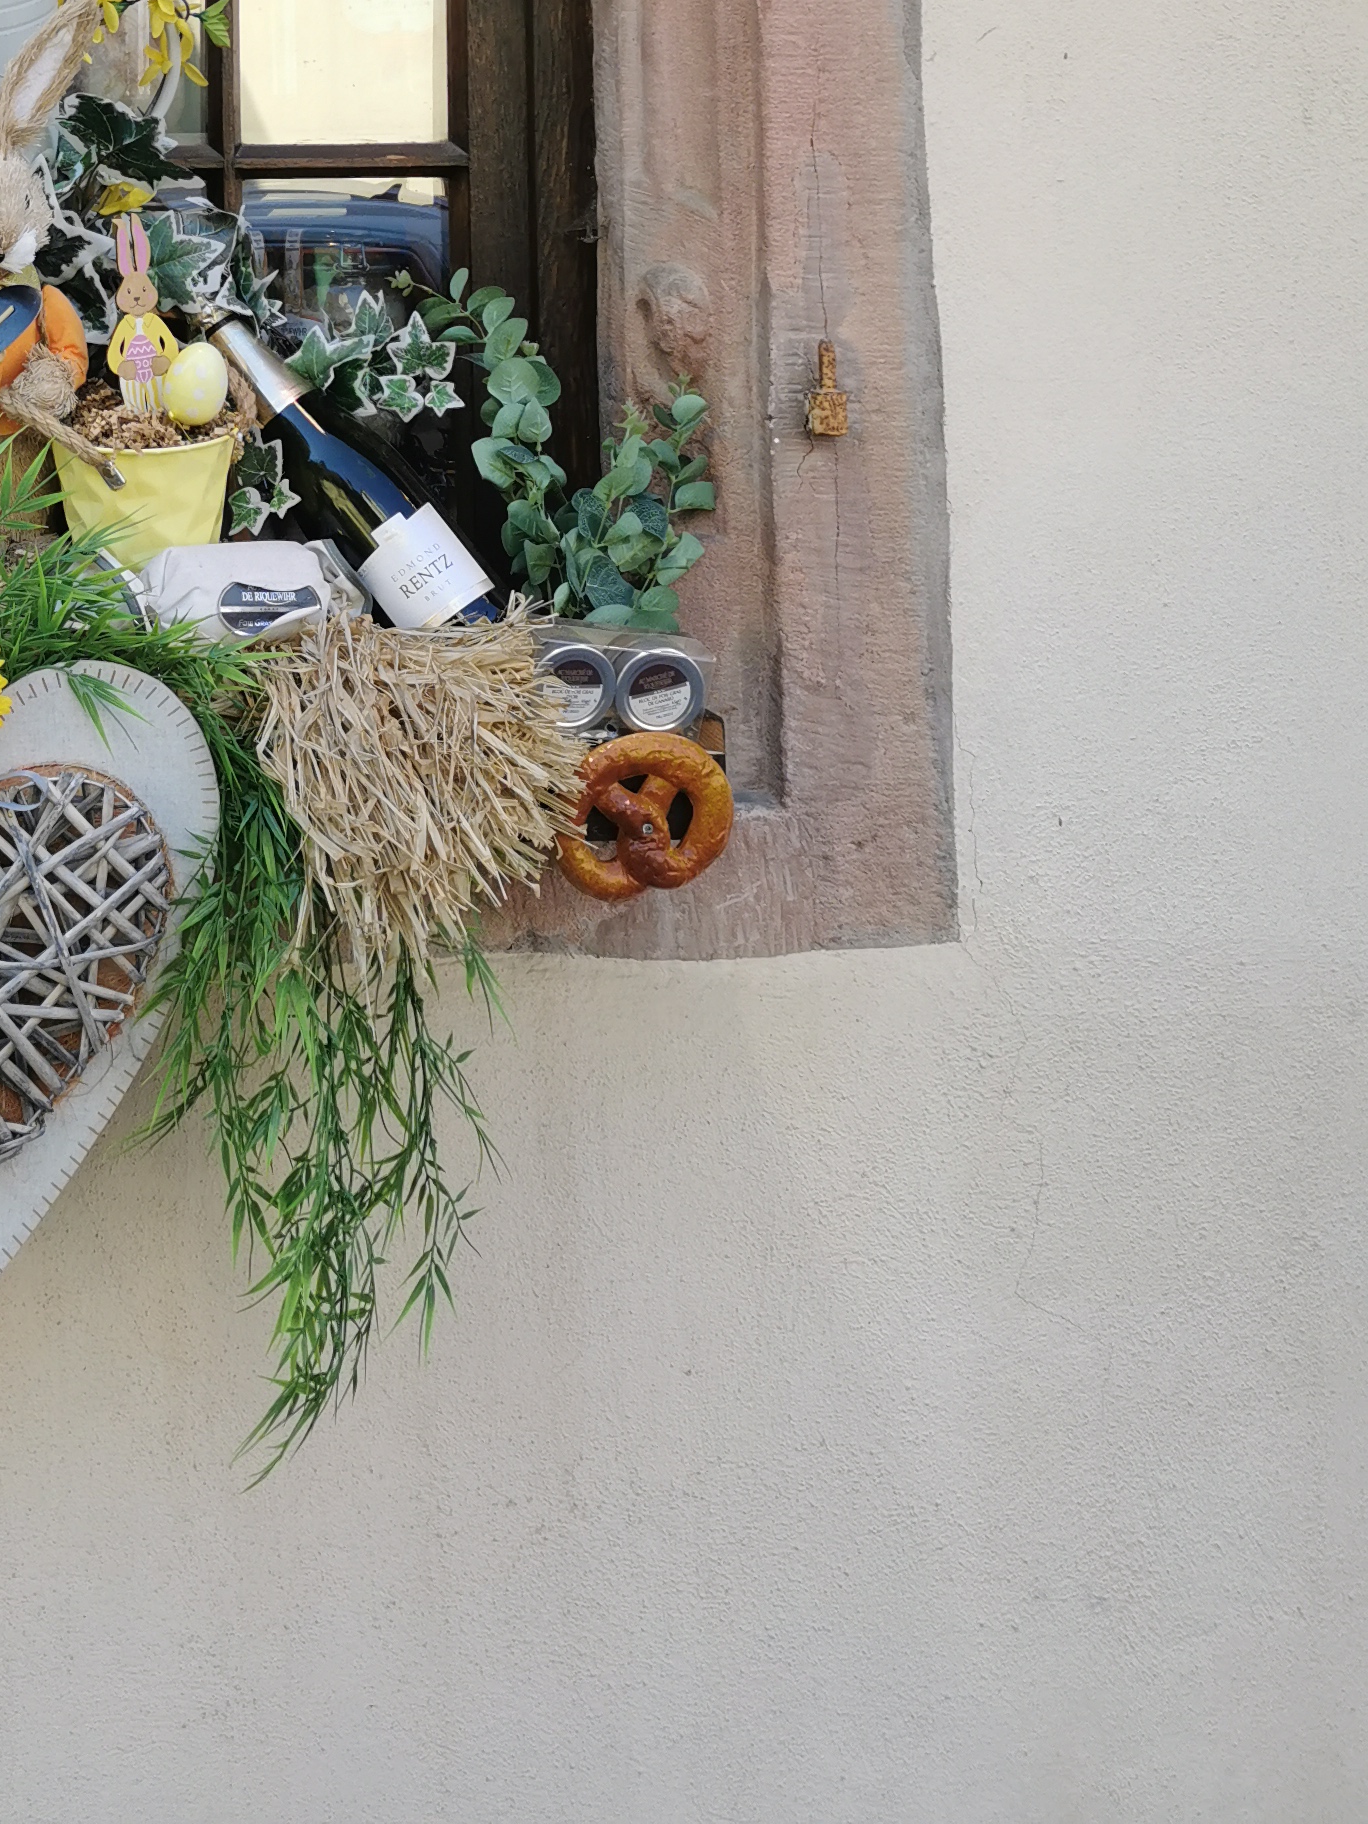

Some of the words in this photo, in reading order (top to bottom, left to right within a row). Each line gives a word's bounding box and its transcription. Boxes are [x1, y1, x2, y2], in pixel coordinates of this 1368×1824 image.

[390, 542, 441, 583] EDMOND
[398, 553, 454, 599] RENTZ
[242, 591, 254, 602] DE
[254, 591, 297, 605] RIQUEWIHR
[424, 579, 453, 602] BRUT
